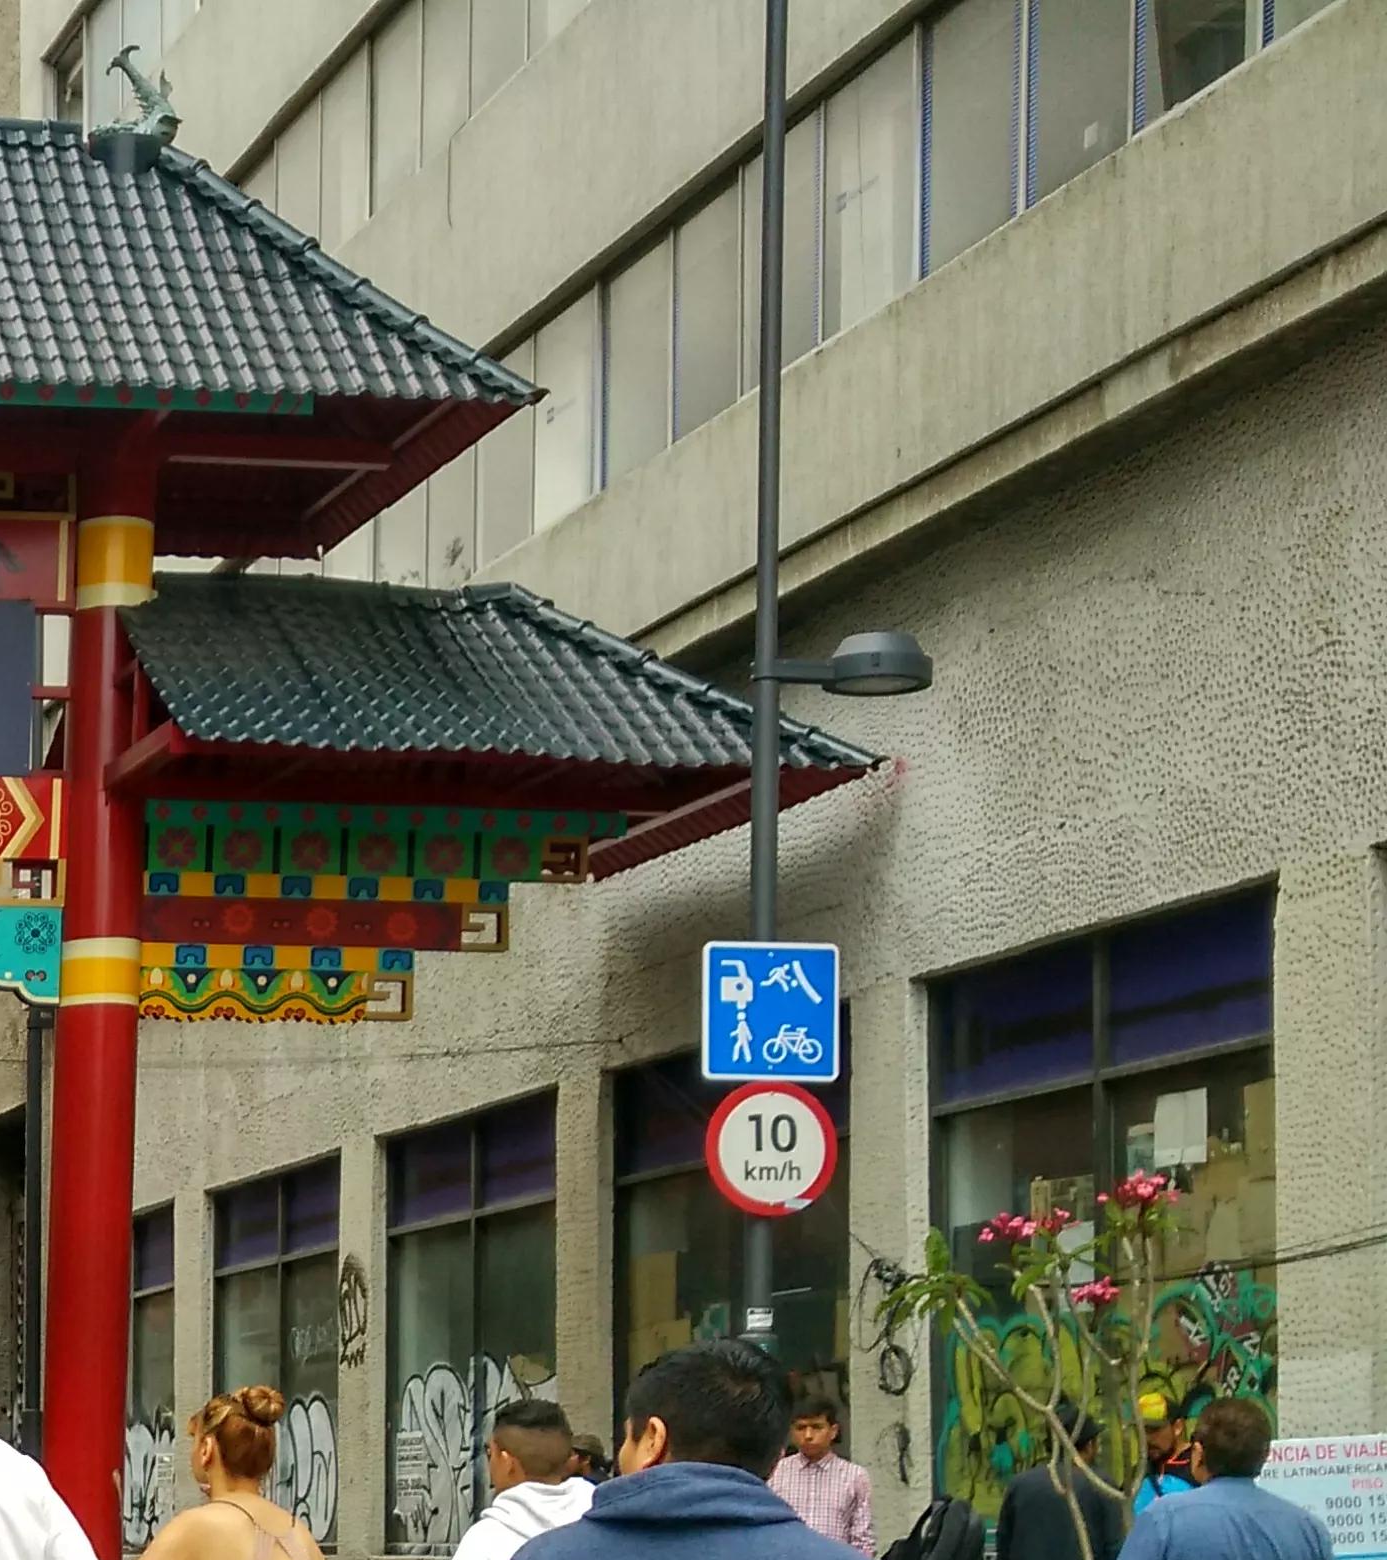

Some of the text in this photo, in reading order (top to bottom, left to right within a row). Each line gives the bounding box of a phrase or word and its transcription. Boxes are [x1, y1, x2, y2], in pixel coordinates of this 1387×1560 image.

[747, 1113, 798, 1153] 10
[743, 1160, 802, 1182] km/h
[1315, 1443, 1337, 1459] DE
[1325, 1496, 1362, 1509] 9000
